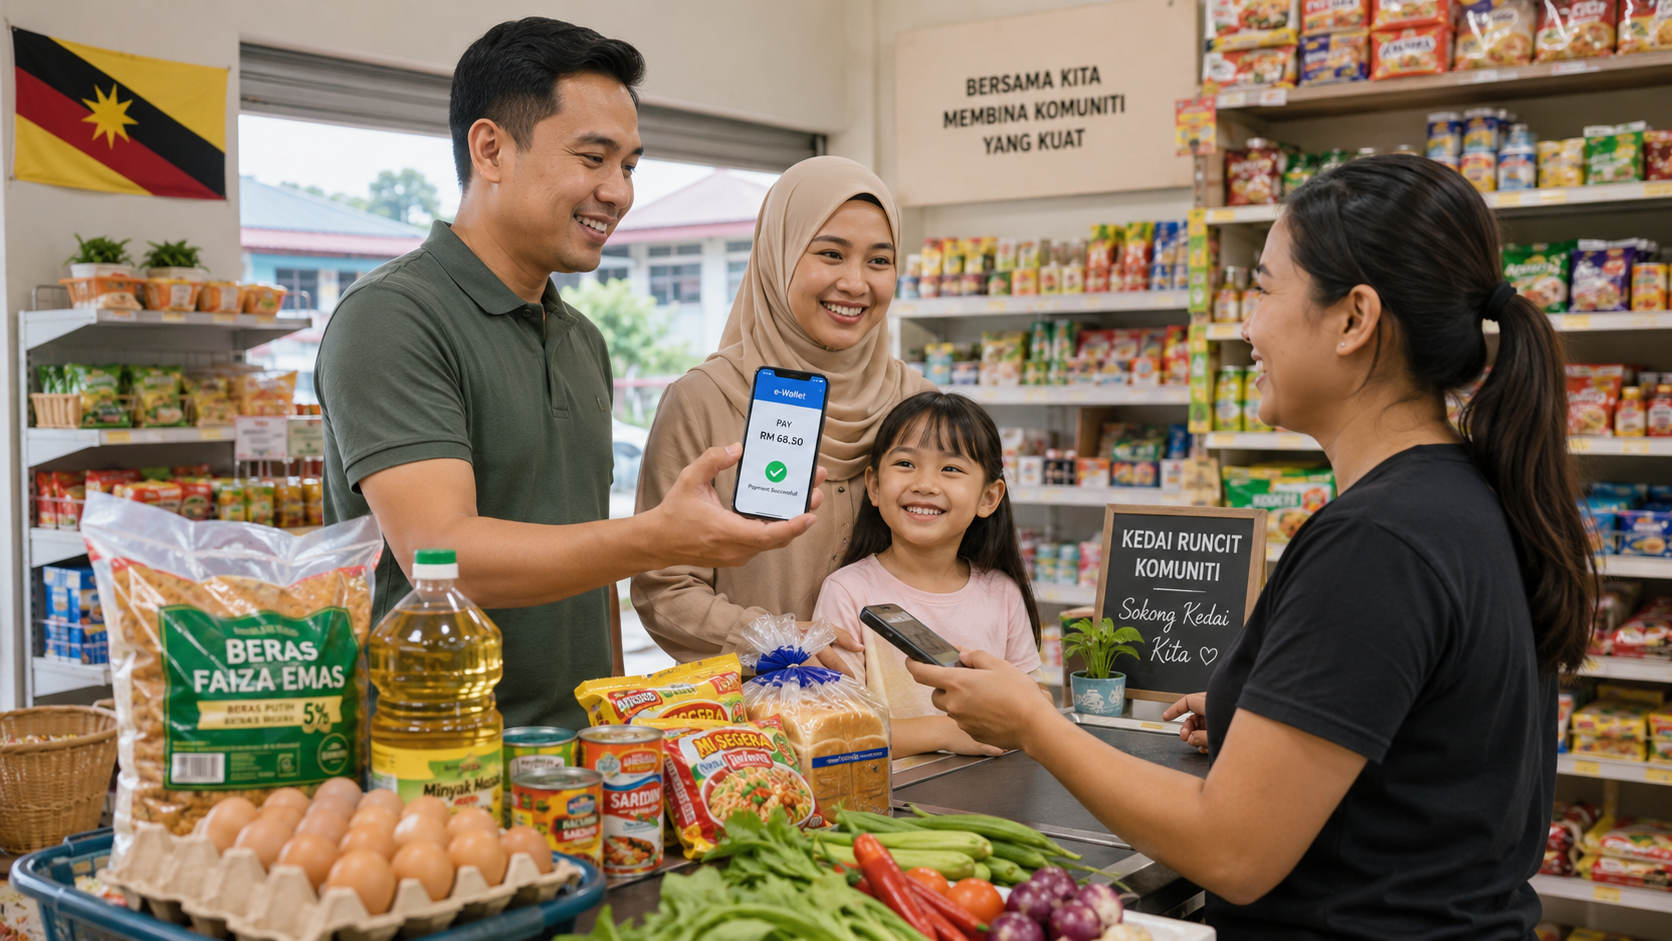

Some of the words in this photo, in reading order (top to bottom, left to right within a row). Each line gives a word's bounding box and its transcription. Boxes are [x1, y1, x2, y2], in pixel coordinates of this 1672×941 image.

[966, 70, 1054, 97] BERSAMA
[1061, 66, 1102, 88] KITA
[943, 103, 1029, 129] MEMBINA
[1034, 94, 1126, 121] KOMUNITI
[983, 132, 1031, 156] YANG
[1038, 128, 1085, 151] KUAT
[773, 388, 807, 400] e-Wallet
[760, 431, 775, 442] RM
[776, 418, 793, 429] PAY
[1121, 529, 1172, 551] KEDAI
[1177, 531, 1243, 554] RUNCIT
[1134, 558, 1221, 582] KOMUNITI
[1118, 596, 1177, 634] Sokong
[1182, 601, 1230, 628] Kedai
[225, 638, 319, 665] BERAS
[1150, 636, 1192, 664] Kita
[193, 667, 276, 693] FAIZA
[281, 665, 346, 691] EMAS
[302, 702, 330, 726] 5%
[694, 736, 717, 757] MI
[715, 731, 776, 751] SEGERA
[423, 779, 472, 801] Minyak
